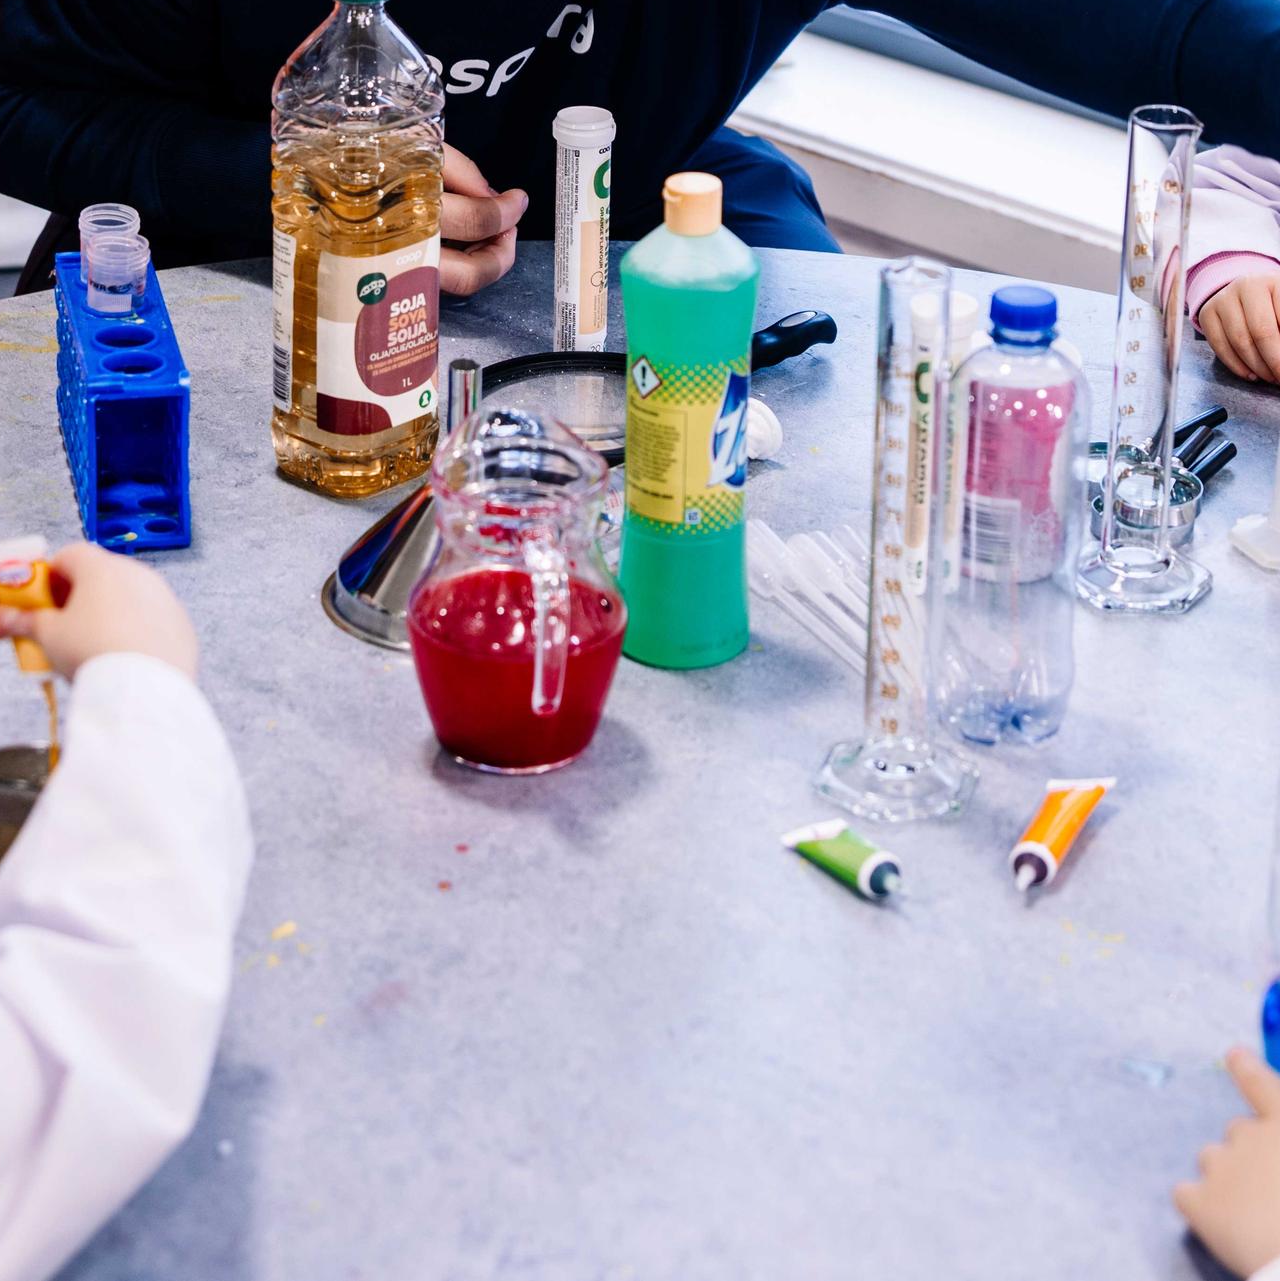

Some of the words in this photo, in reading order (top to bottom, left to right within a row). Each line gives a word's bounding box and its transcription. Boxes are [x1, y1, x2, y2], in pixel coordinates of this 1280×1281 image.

[396, 250, 422, 266] coop
[390, 292, 426, 317] SOJA
[388, 307, 427, 332] SOYA
[387, 321, 428, 347] SOIJA
